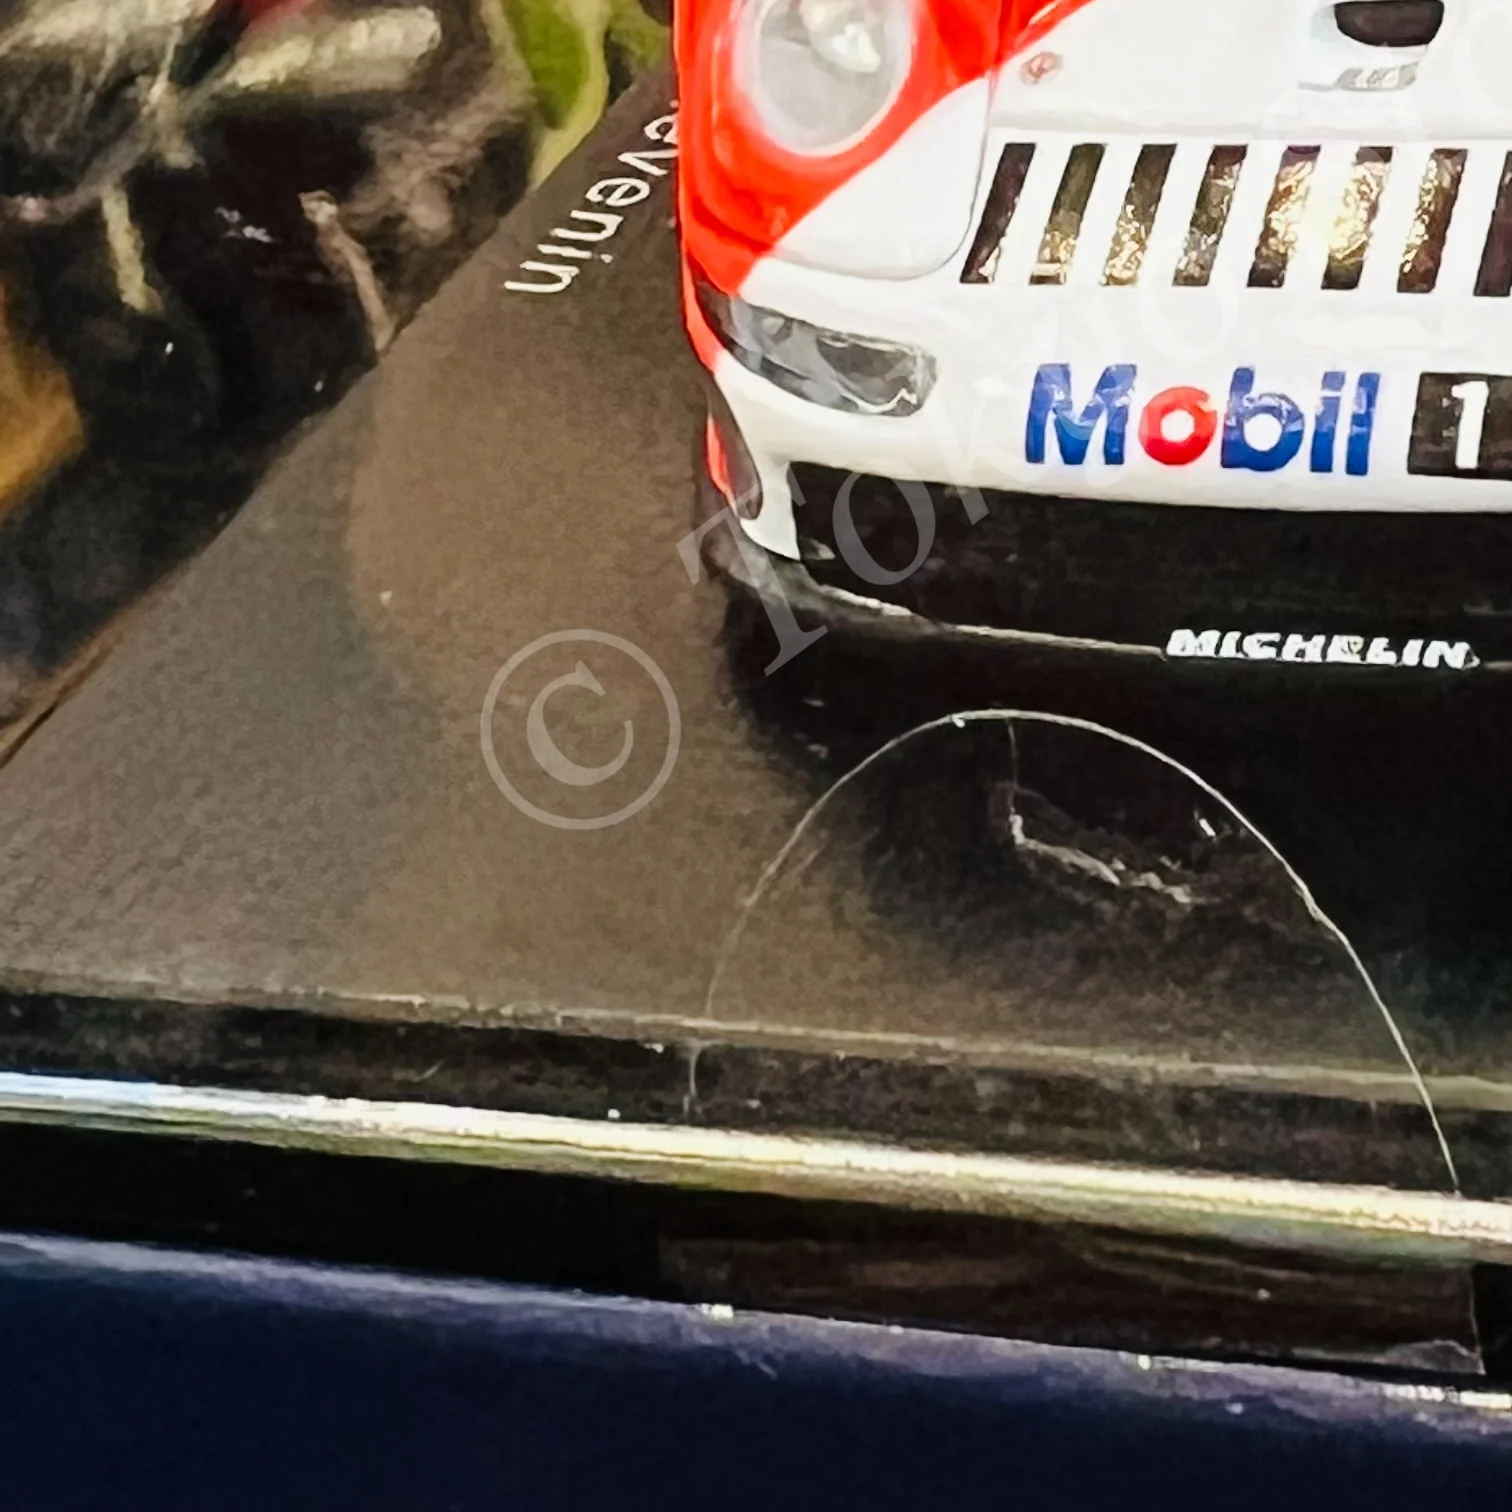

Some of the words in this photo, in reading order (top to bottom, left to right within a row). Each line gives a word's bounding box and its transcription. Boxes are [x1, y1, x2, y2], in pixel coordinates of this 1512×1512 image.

[1024, 362, 1382, 476] Mobil
[1450, 380, 1491, 470] 1
[1165, 627, 1480, 671] MICHELIN
